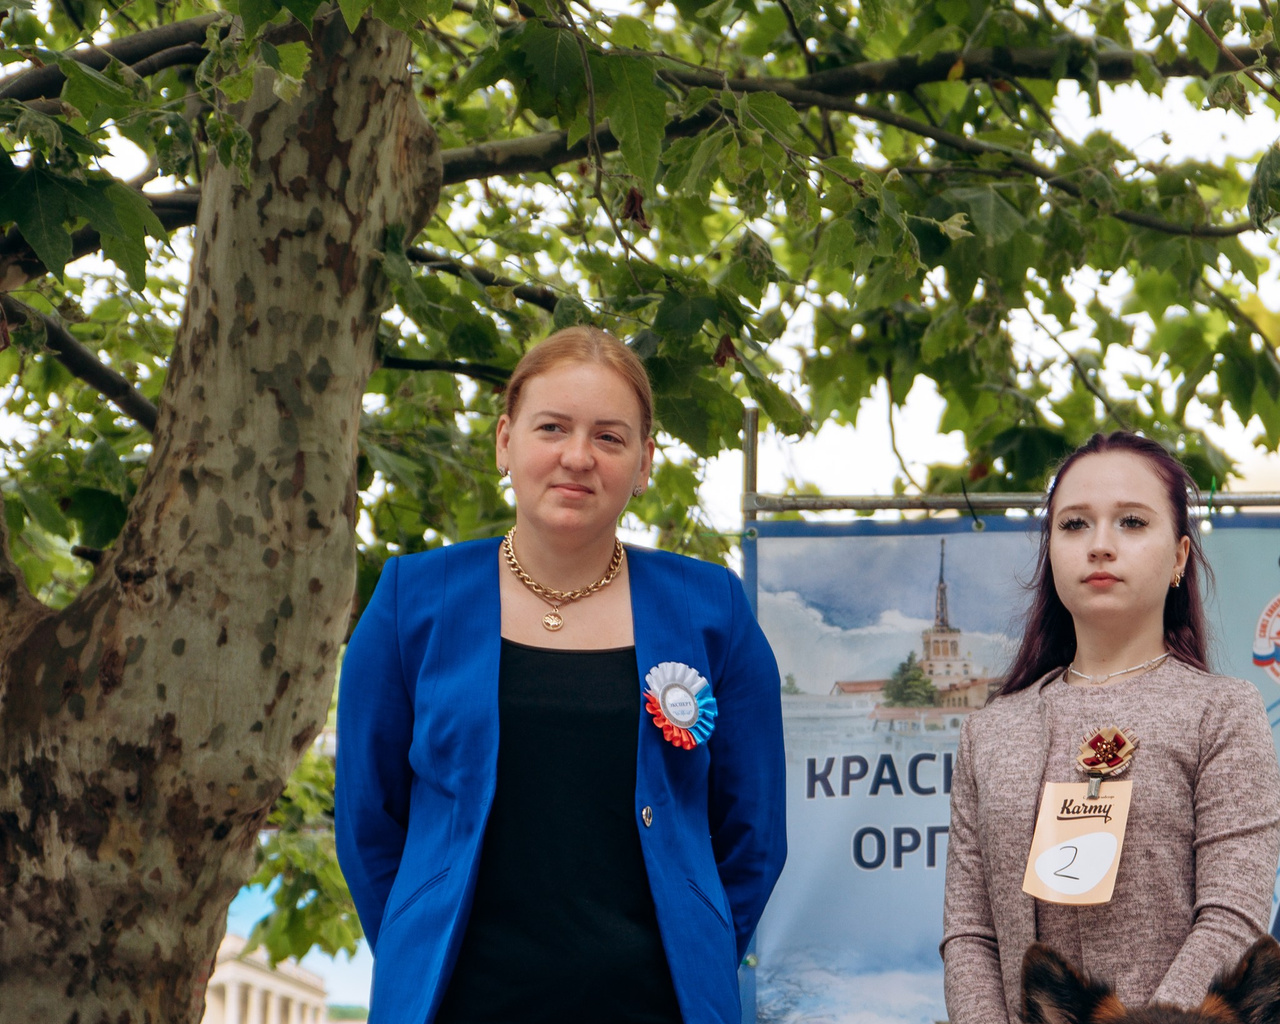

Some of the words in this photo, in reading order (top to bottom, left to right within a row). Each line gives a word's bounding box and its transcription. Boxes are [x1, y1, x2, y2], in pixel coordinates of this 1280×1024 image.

[806, 752, 953, 799] КРАС
[1058, 798, 1113, 823] Karmy
[1053, 845, 1080, 880] 2
